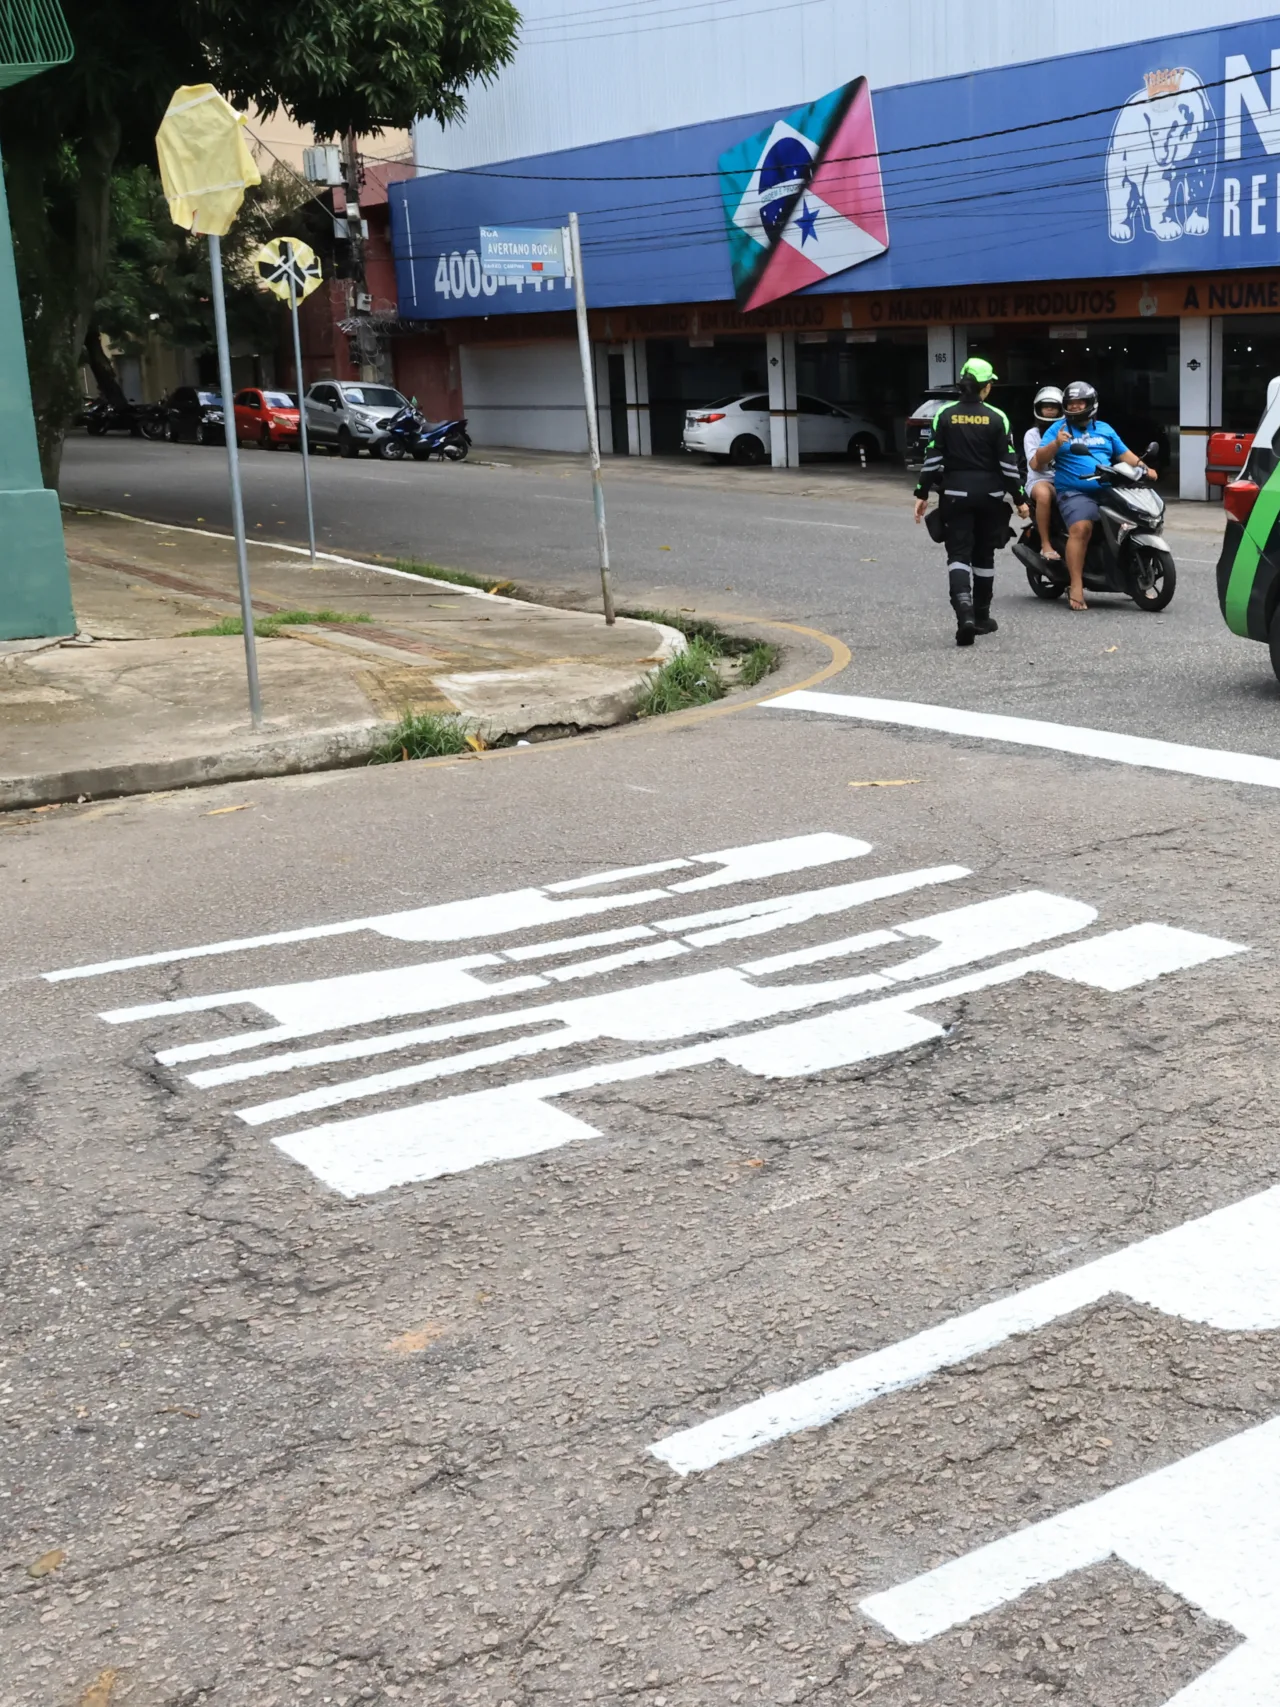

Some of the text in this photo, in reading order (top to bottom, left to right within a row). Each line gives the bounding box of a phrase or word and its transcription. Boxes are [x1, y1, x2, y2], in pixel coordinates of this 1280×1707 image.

[480, 229, 499, 238] RUA
[487, 242, 557, 256] AVERTANO ROCHA
[1014, 290, 1116, 316] PRODUTOS
[1183, 284, 1200, 310] A
[934, 352, 947, 364] 165
[951, 414, 990, 425] SEMOB
[40, 832, 1248, 1198] PARE
